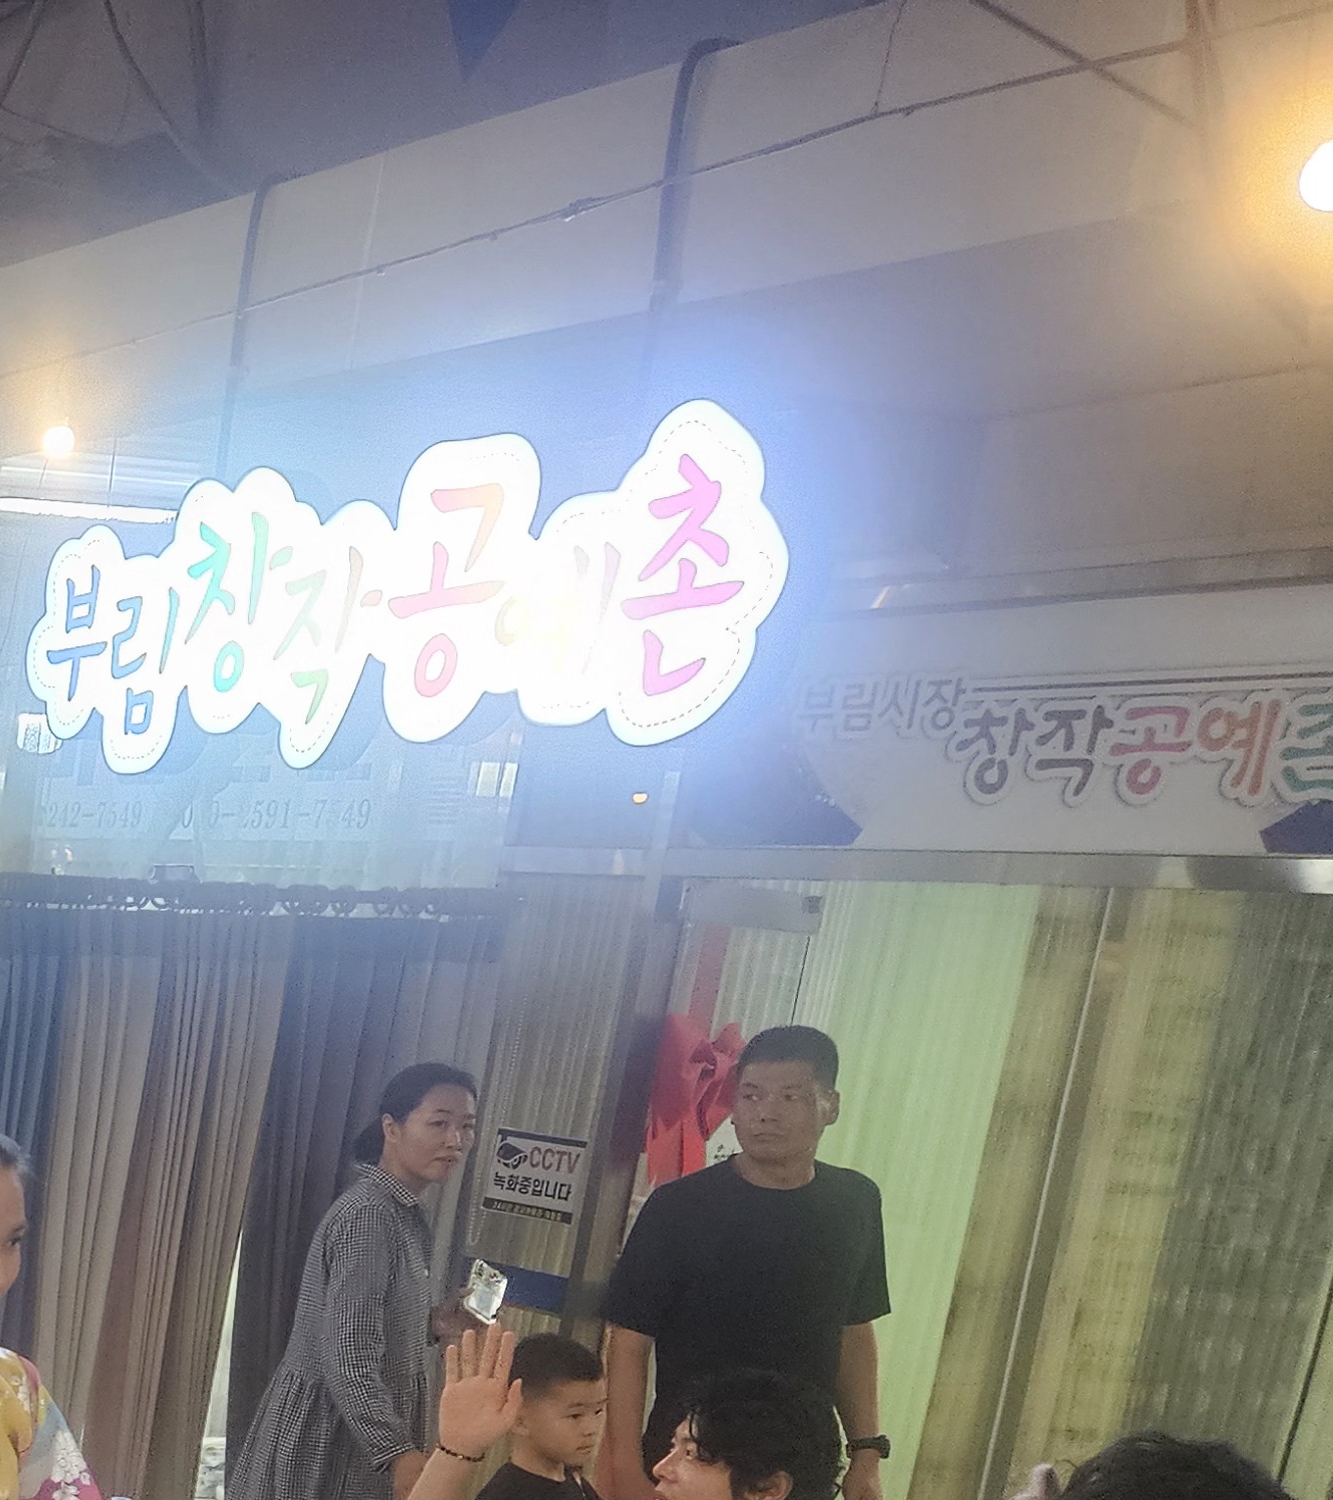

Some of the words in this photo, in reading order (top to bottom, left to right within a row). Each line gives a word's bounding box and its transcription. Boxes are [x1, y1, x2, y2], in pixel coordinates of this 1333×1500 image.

[47, 454, 745, 735] 부림창작공예촌
[799, 677, 967, 732] 부림시장
[529, 1146, 581, 1174] CCTV
[493, 1171, 573, 1202] 녹화중입니다
